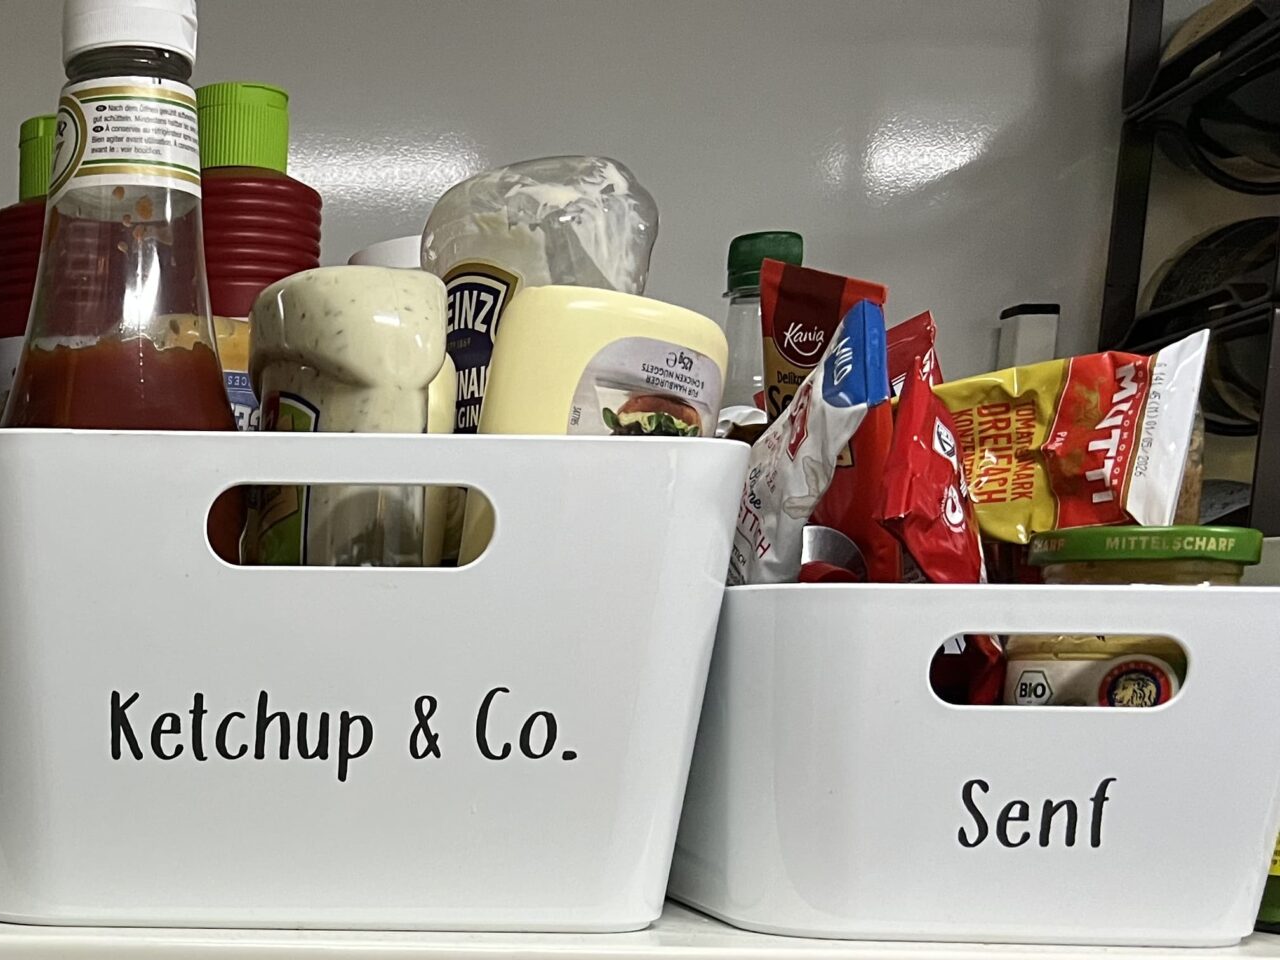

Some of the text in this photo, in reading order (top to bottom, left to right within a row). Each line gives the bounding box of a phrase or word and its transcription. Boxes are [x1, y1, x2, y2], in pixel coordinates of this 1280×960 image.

[784, 322, 824, 352] Kania
[641, 363, 701, 388] CHICKEN NUGGETS
[645, 374, 687, 394] HAMBURGER
[1086, 362, 1140, 503] MUTTI
[1105, 535, 1236, 552] MITTELSCHARF
[1020, 682, 1046, 699] BIO
[111, 688, 577, 782] Ketchup & Co.
[959, 778, 1116, 847] Senf
